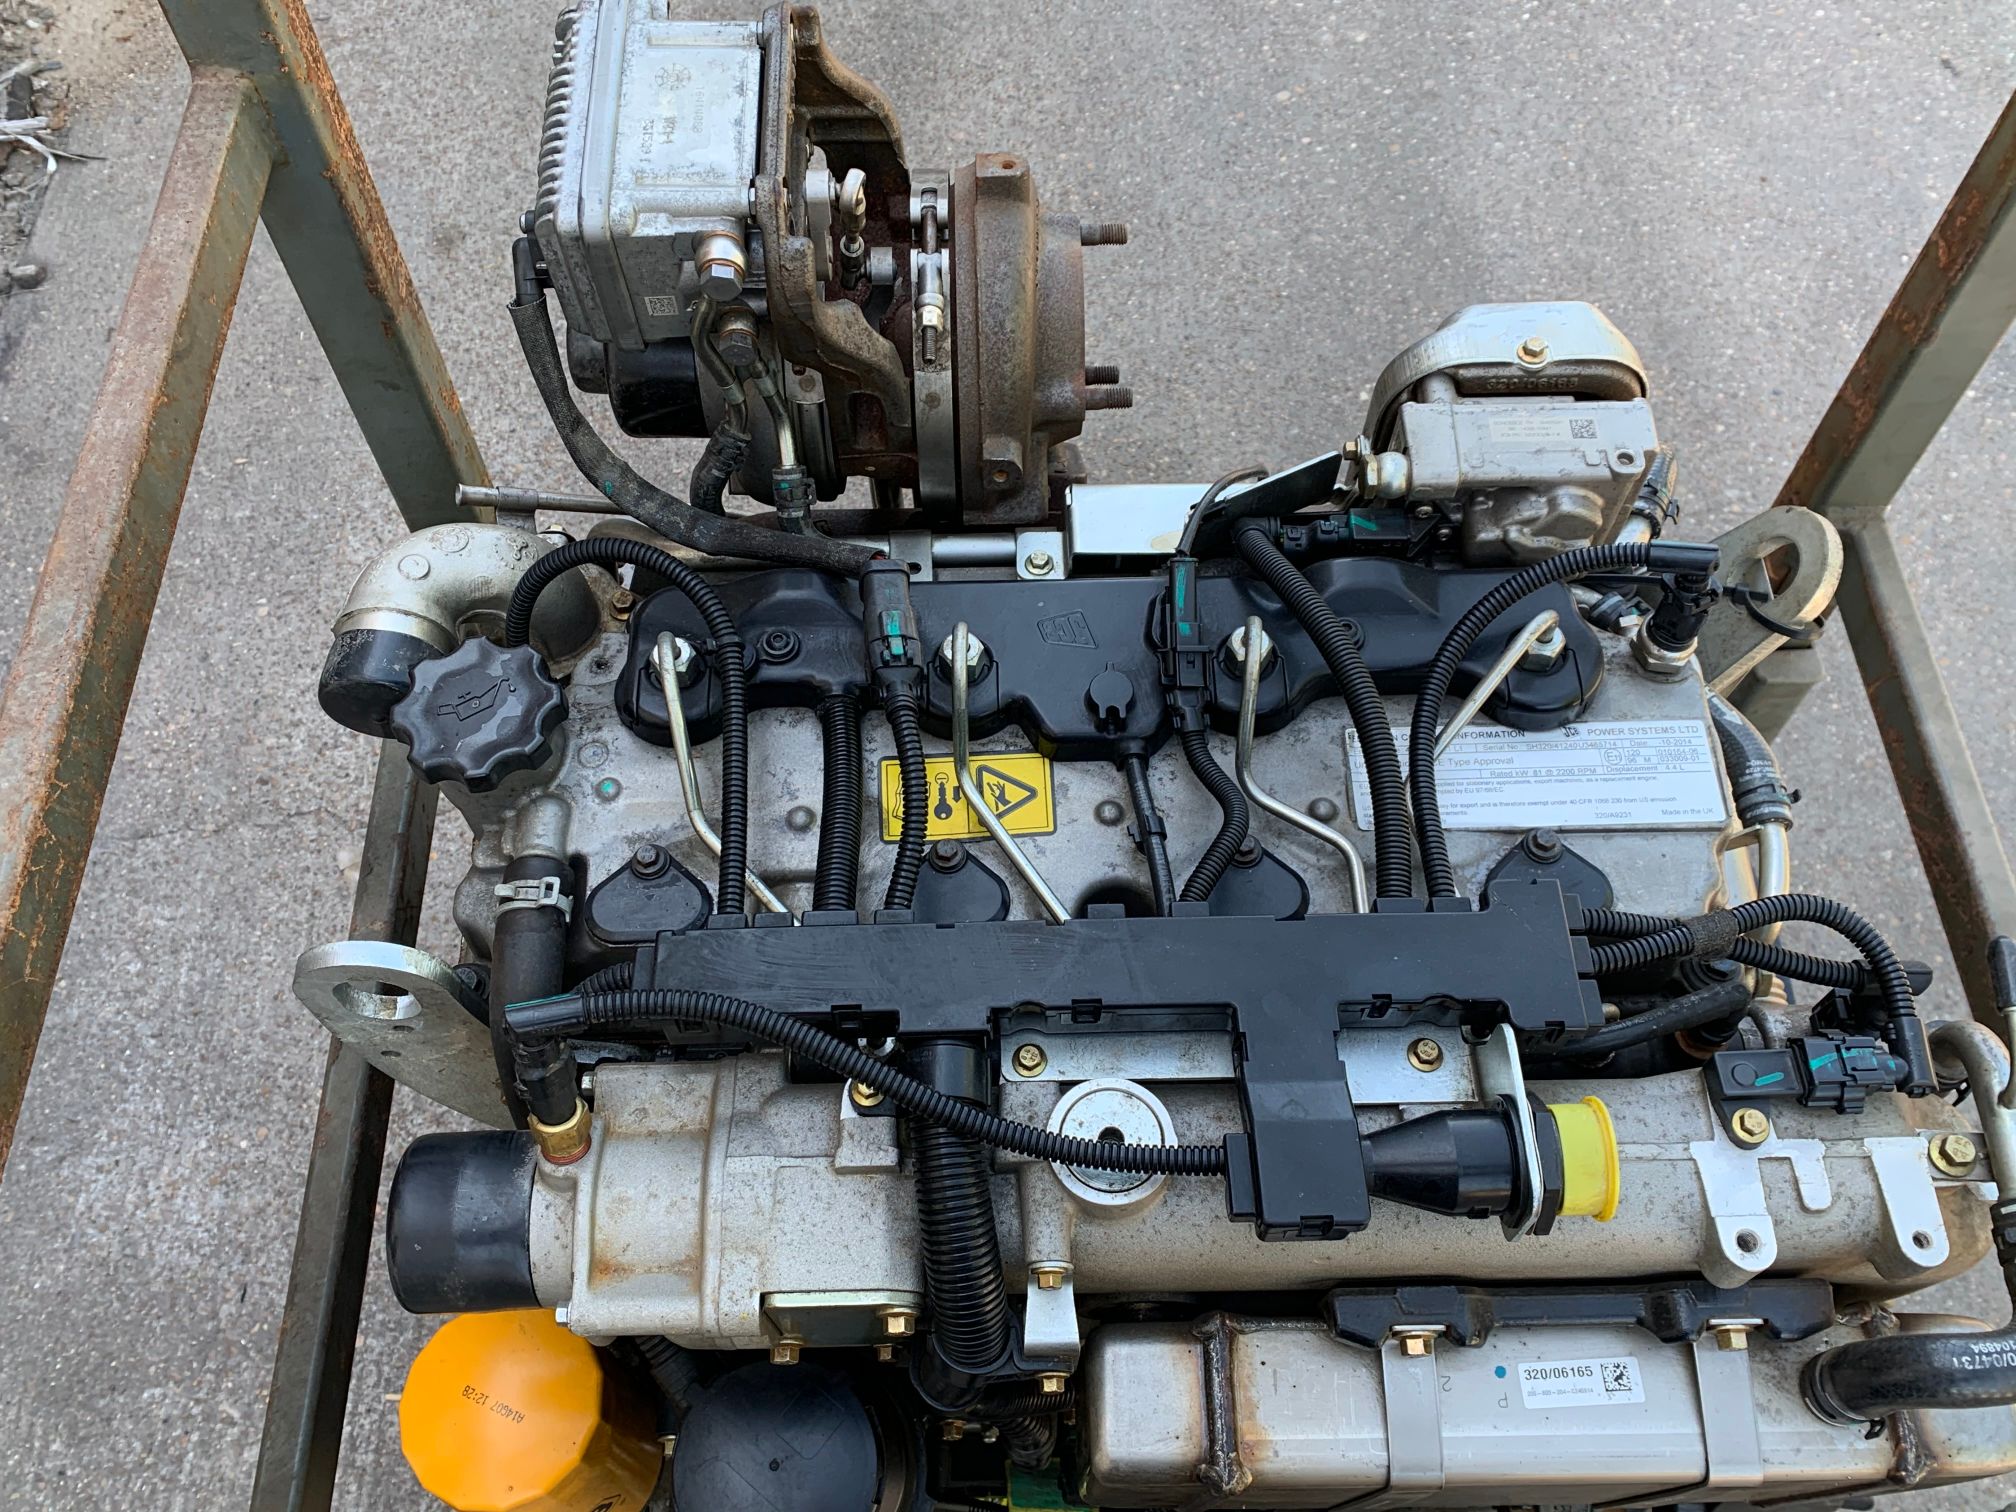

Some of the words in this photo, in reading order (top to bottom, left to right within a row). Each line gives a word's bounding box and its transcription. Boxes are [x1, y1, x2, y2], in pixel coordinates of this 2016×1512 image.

[1457, 730, 1526, 739] NFORMATION
[1587, 728, 1626, 736] POWER
[1628, 726, 1677, 735] SYSTEMS
[1679, 725, 1699, 734] LTD
[1482, 743, 1506, 751] Serial
[1448, 758, 1471, 767] Type
[1474, 756, 1514, 767] Approval
[1490, 769, 1513, 777] Rated
[1515, 769, 1529, 777] kW
[1577, 767, 1597, 775] RPM
[1606, 765, 1658, 773] Displacement
[1523, 1365, 1593, 1381] 320/06165
